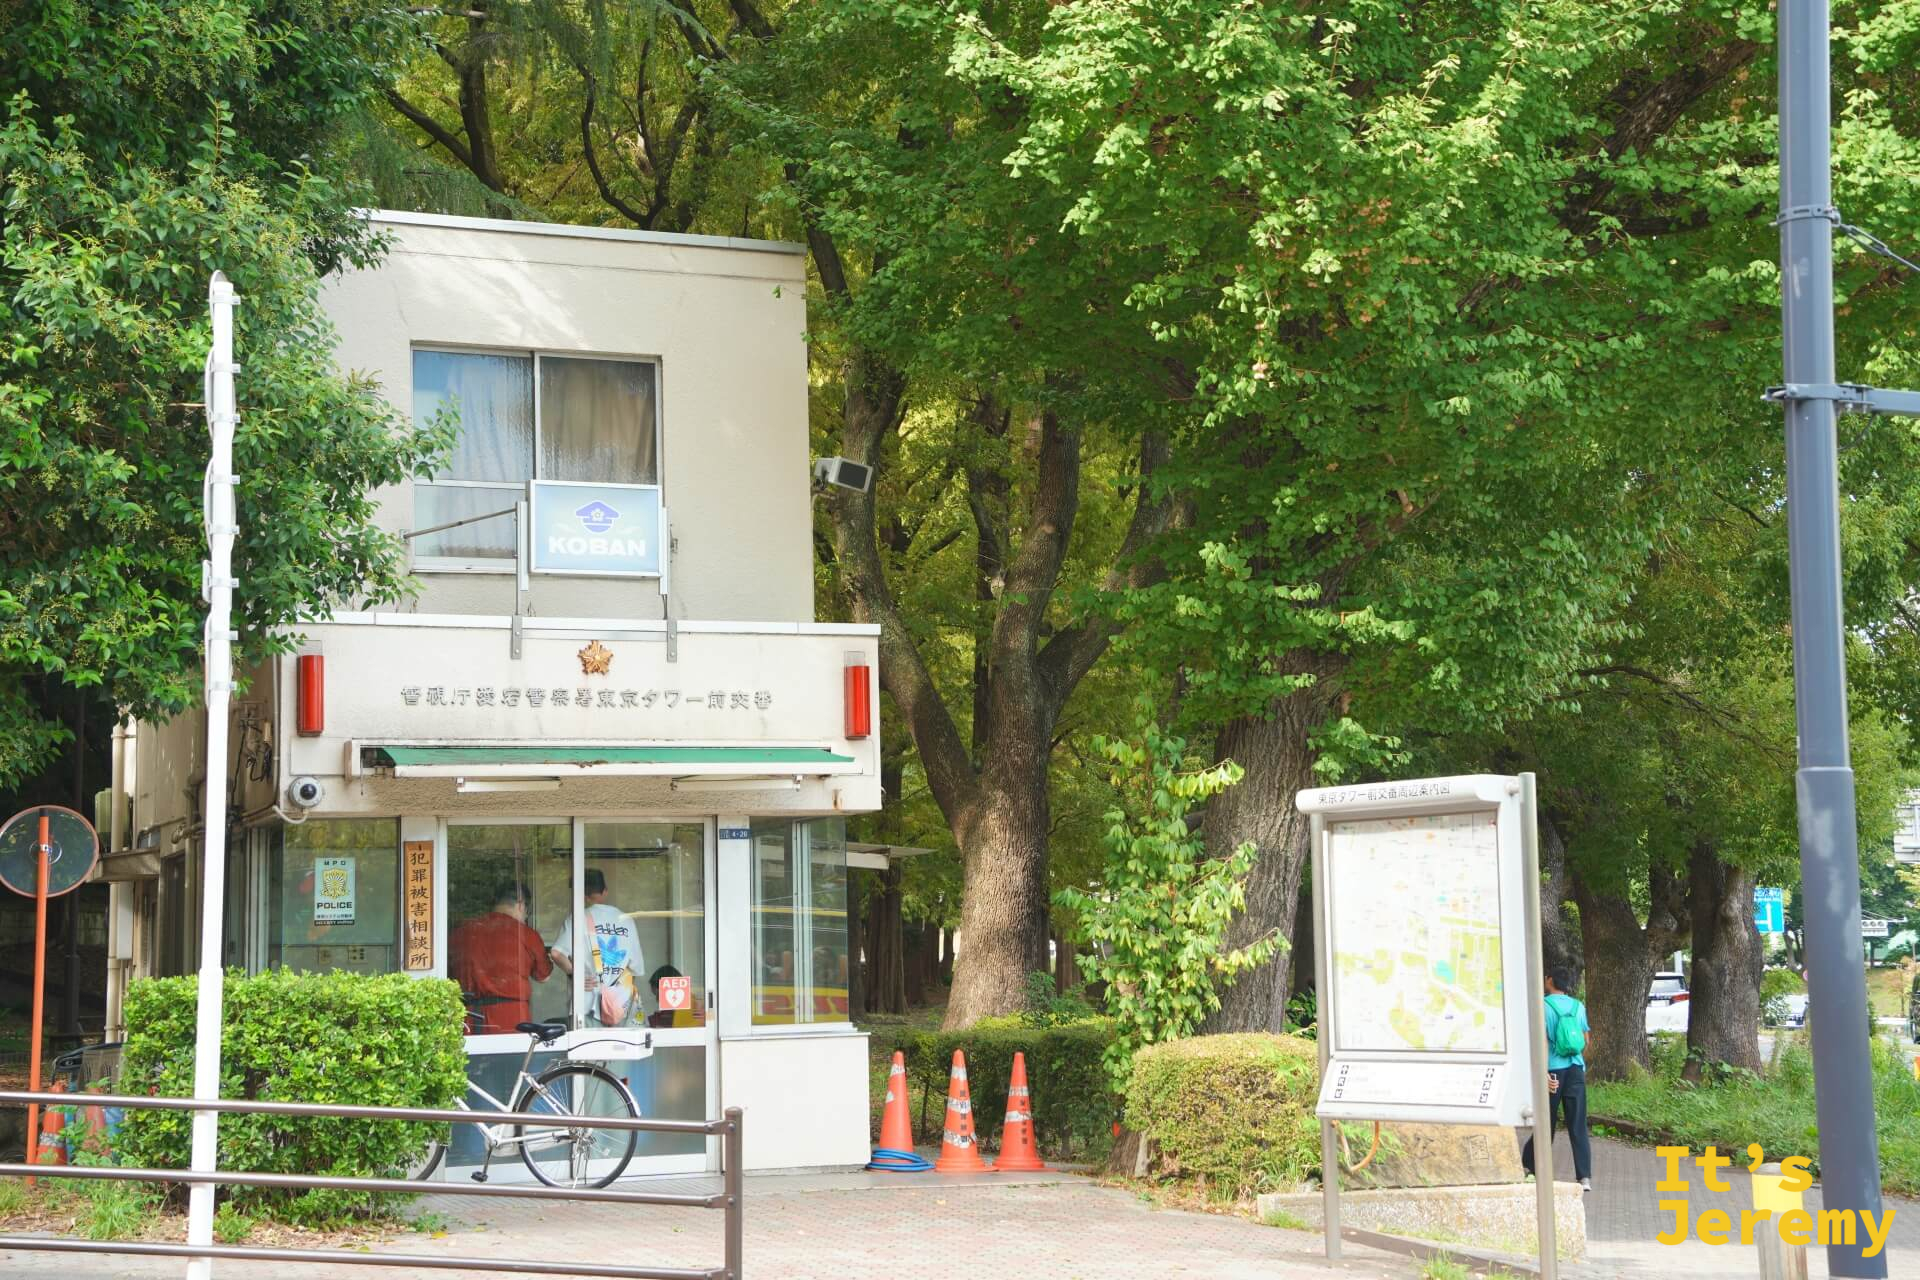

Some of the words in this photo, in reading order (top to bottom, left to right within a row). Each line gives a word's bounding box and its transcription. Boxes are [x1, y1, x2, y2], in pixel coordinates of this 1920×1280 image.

[548, 536, 646, 557] KOBAN
[316, 901, 353, 910] POLICE
[409, 852, 431, 967] 犯罪被害相談所
[662, 978, 688, 989] AED
